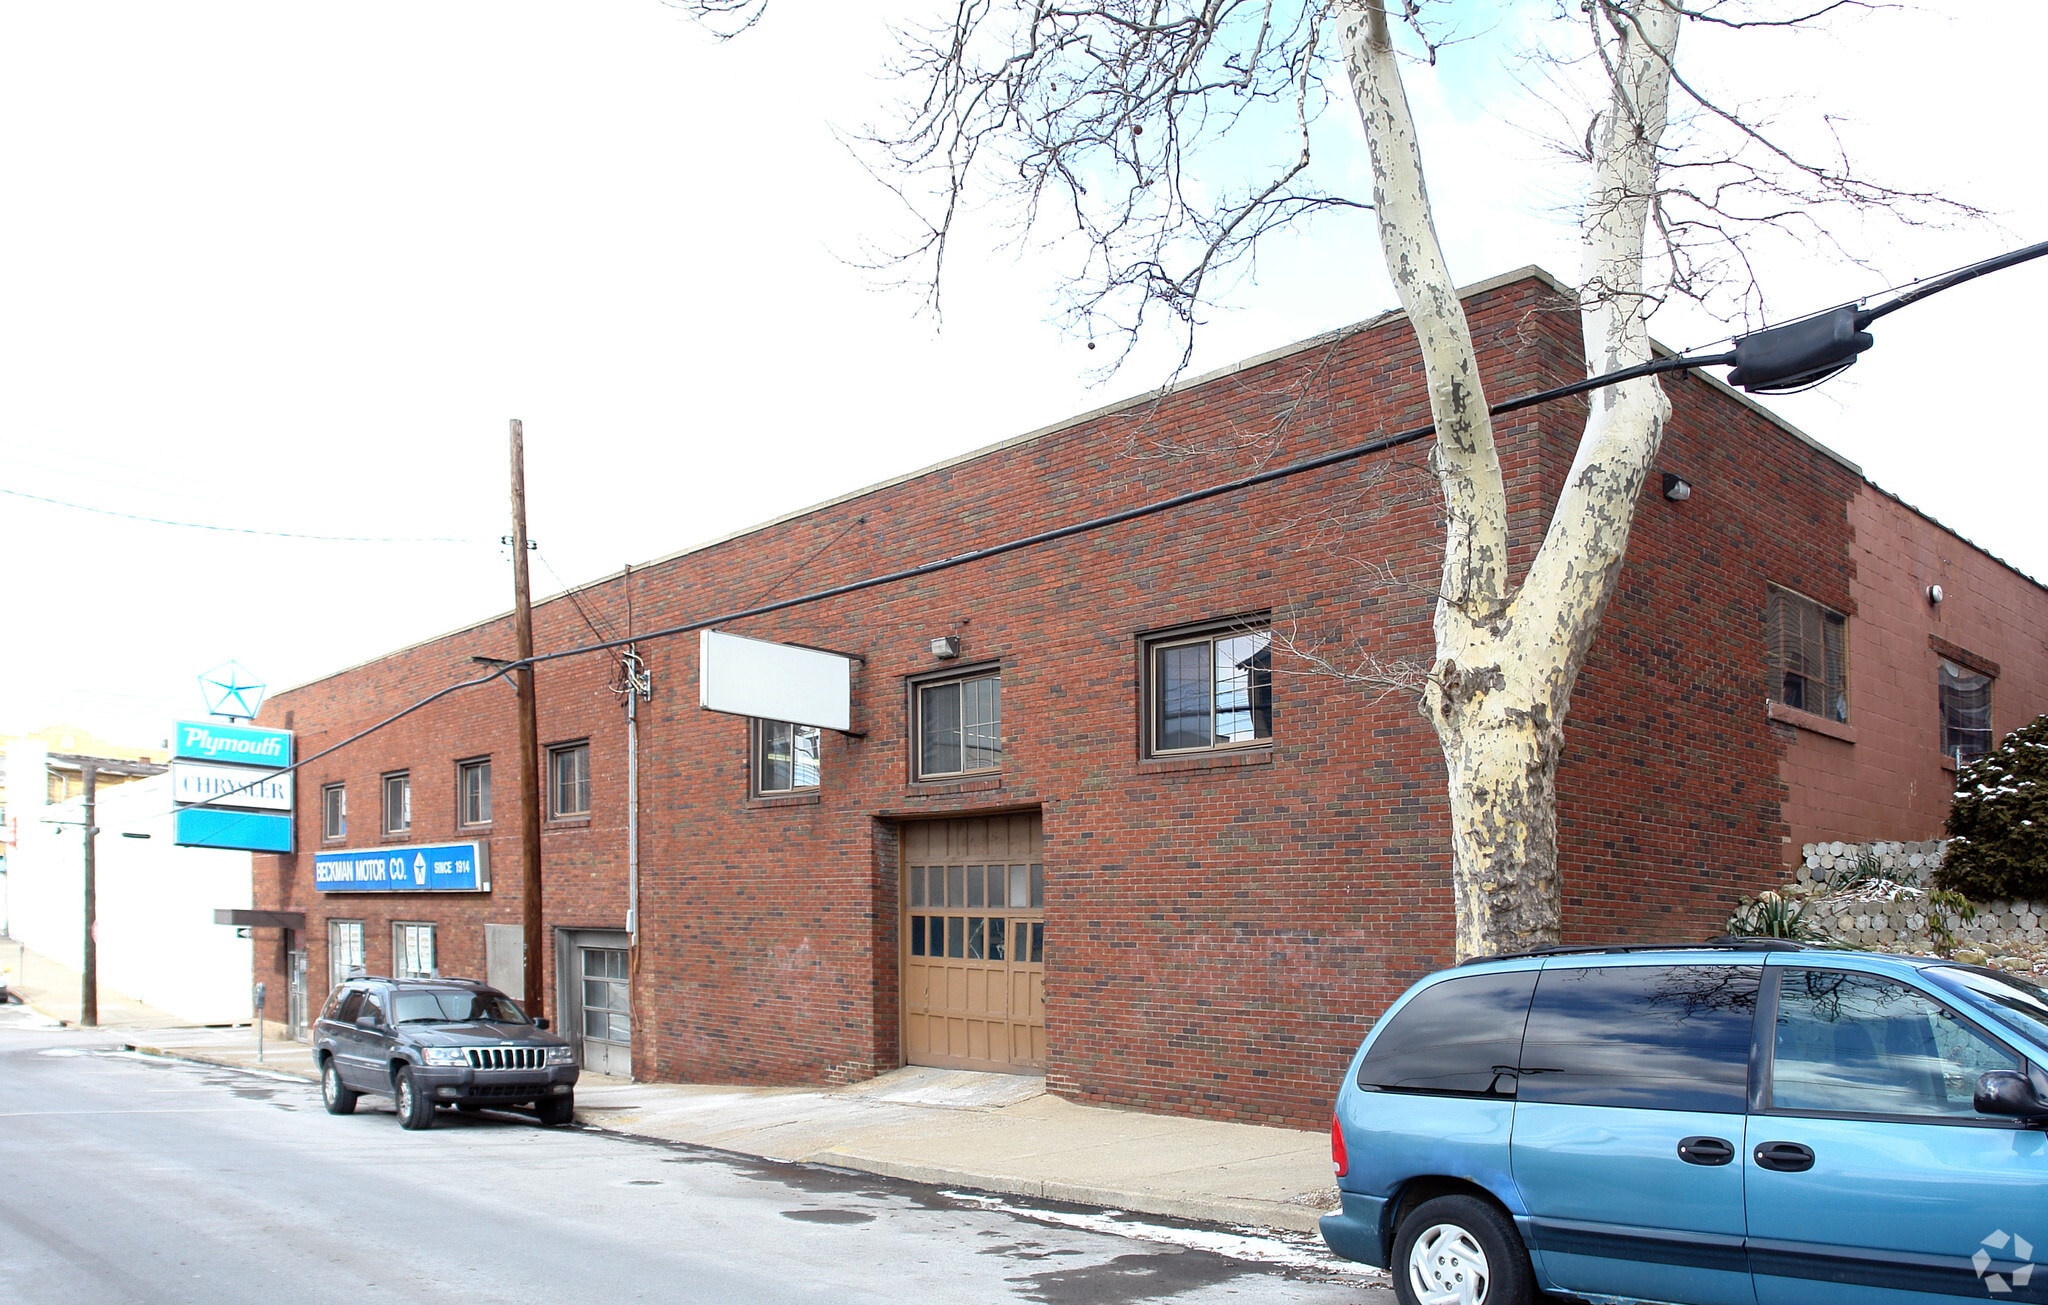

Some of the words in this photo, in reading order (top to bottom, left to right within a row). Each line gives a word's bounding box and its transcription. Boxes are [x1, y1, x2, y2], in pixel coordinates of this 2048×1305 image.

[183, 727, 282, 757] Plymouth
[183, 776, 284, 800] CHRYSLER
[316, 859, 354, 882] BECKMAN
[355, 859, 386, 881] MOTOR
[389, 857, 407, 881] CO.
[434, 861, 452, 874] SINCE
[455, 859, 470, 874] 1914
